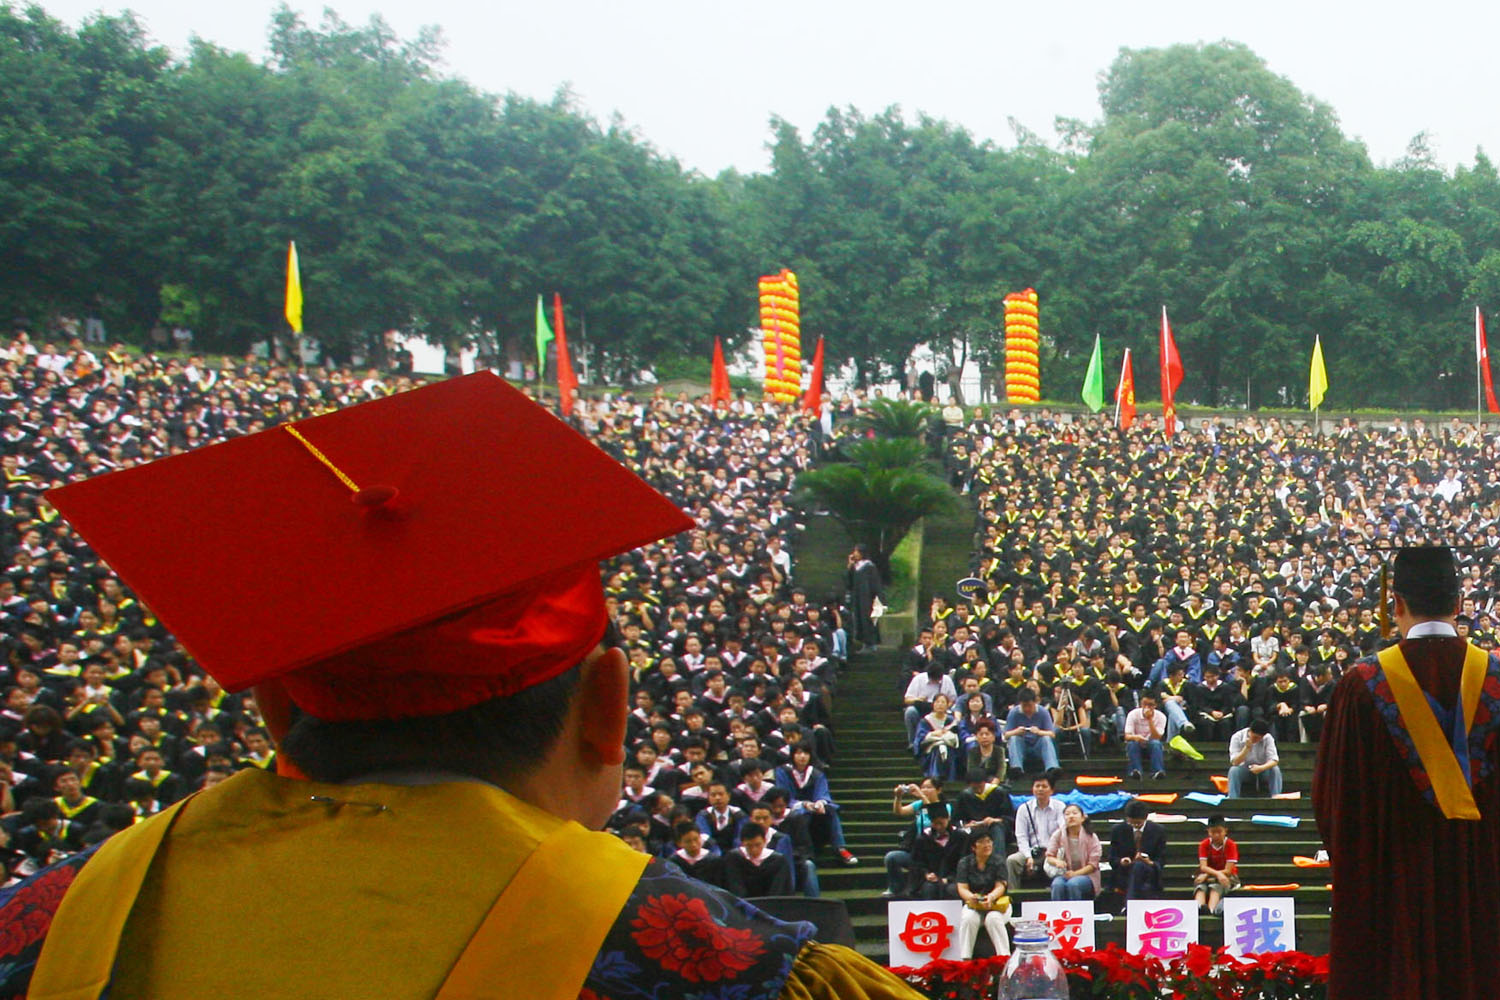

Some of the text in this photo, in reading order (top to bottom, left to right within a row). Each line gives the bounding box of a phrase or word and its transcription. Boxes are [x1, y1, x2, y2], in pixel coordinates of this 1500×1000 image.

[898, 907, 1286, 961] 母 校 是 我
